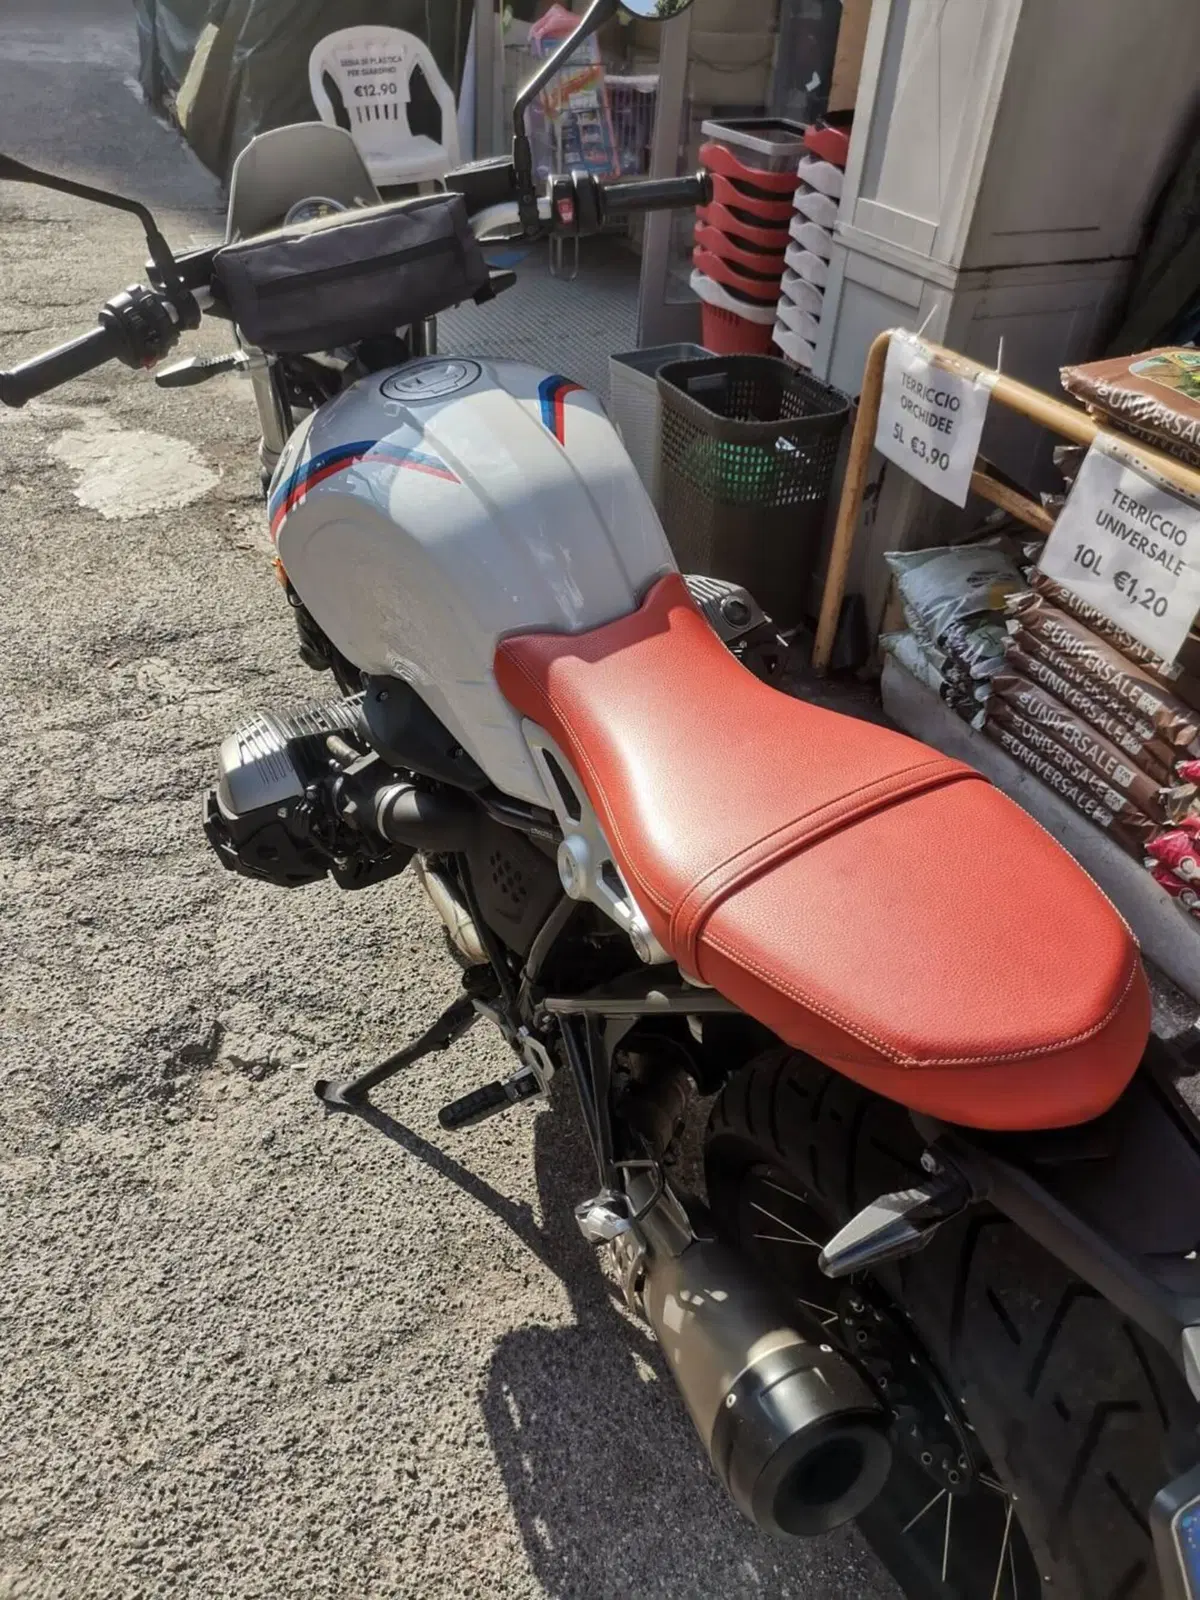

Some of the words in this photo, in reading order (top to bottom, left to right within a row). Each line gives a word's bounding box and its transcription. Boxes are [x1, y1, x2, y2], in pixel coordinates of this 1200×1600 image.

[900, 395, 954, 435] ORCHIDEE
[901, 372, 960, 411] TERRICCIO
[893, 422, 904, 444] 5L
[911, 436, 950, 471] €3,90
[1095, 509, 1187, 577] UNIVERSALE
[1112, 489, 1187, 546] TERRICCIO
[1073, 544, 1102, 576] 10L
[1113, 570, 1168, 617] €1,20
[1028, 697, 1118, 775] UNIVERSALE
[1039, 664, 1123, 741] UNIVERSALE
[1010, 739, 1098, 815] UNIVERSALE
